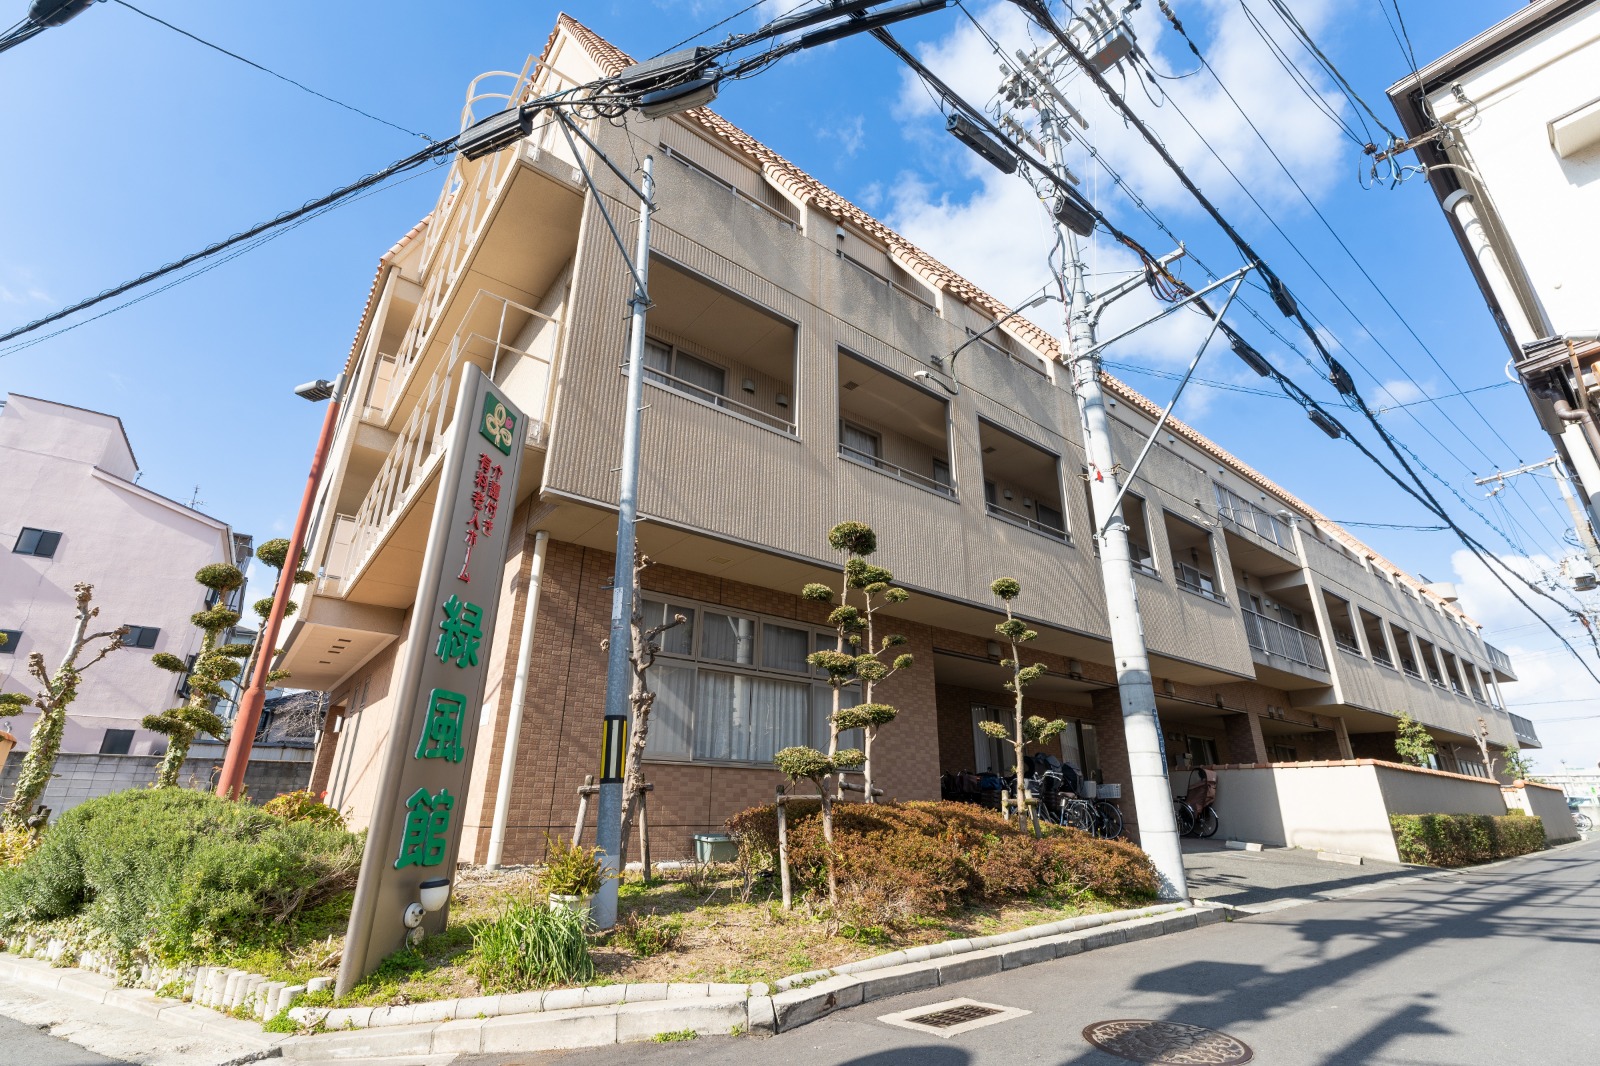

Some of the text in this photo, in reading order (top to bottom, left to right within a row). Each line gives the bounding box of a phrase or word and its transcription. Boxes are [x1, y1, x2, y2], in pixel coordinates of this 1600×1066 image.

[457, 453, 492, 583] 有料老人ホーム
[482, 464, 503, 537] 介護付き
[394, 594, 484, 869] 緑風館
